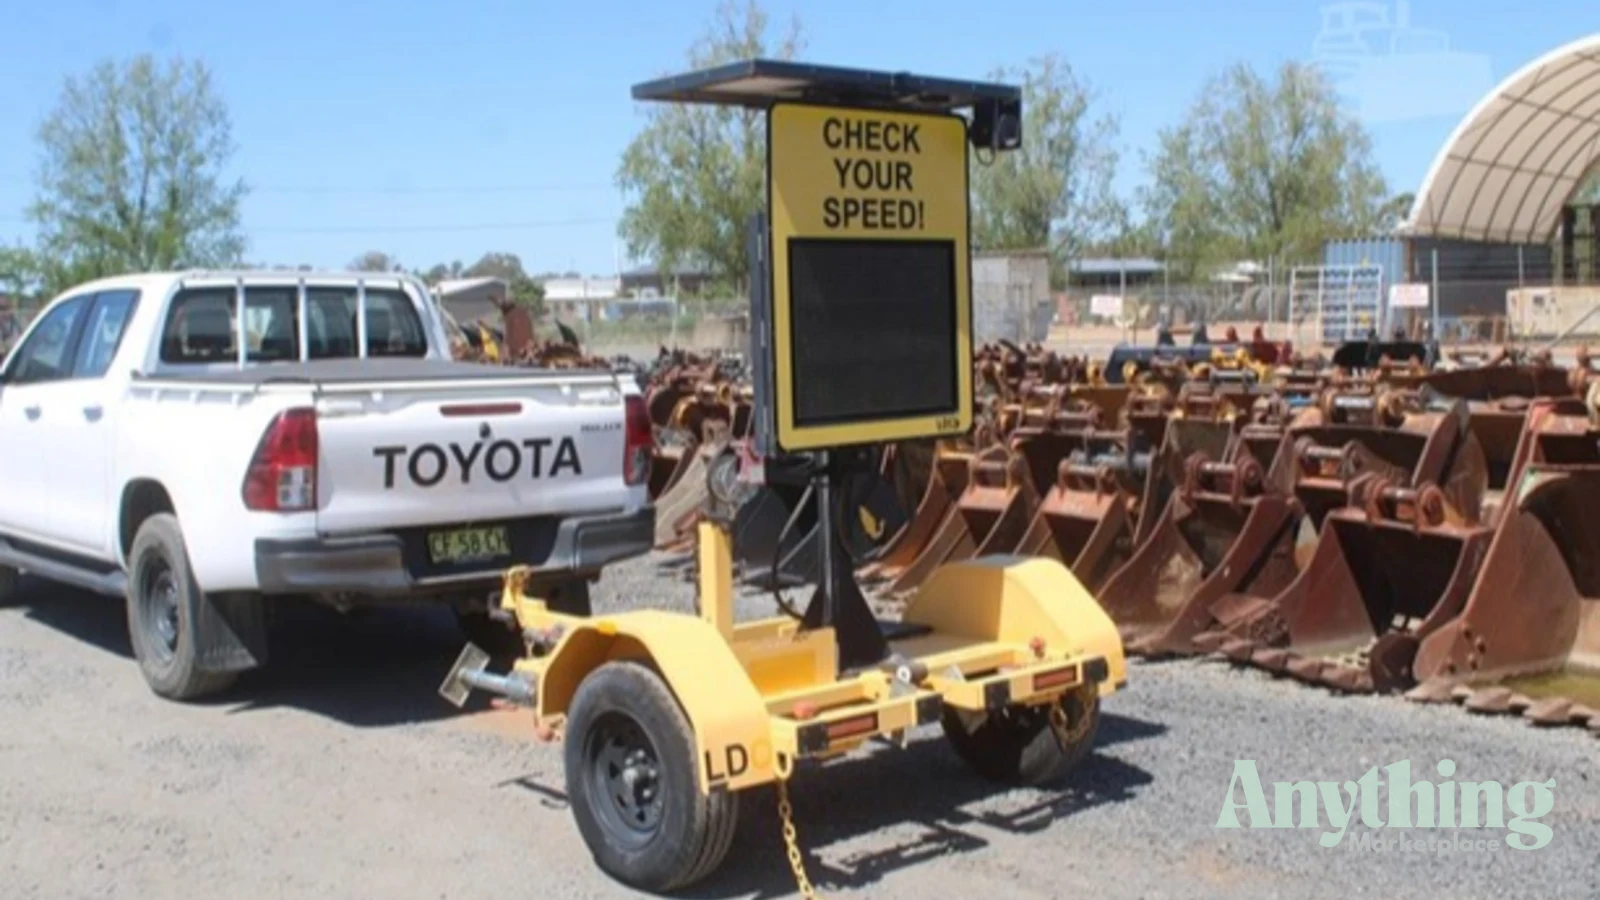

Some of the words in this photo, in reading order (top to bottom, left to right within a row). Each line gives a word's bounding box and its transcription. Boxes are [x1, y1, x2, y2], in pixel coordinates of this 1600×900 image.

[823, 116, 921, 154] CHECK
[833, 157, 914, 192] YOUR
[823, 197, 925, 231] SPEED!
[373, 435, 582, 489] TOYOTA
